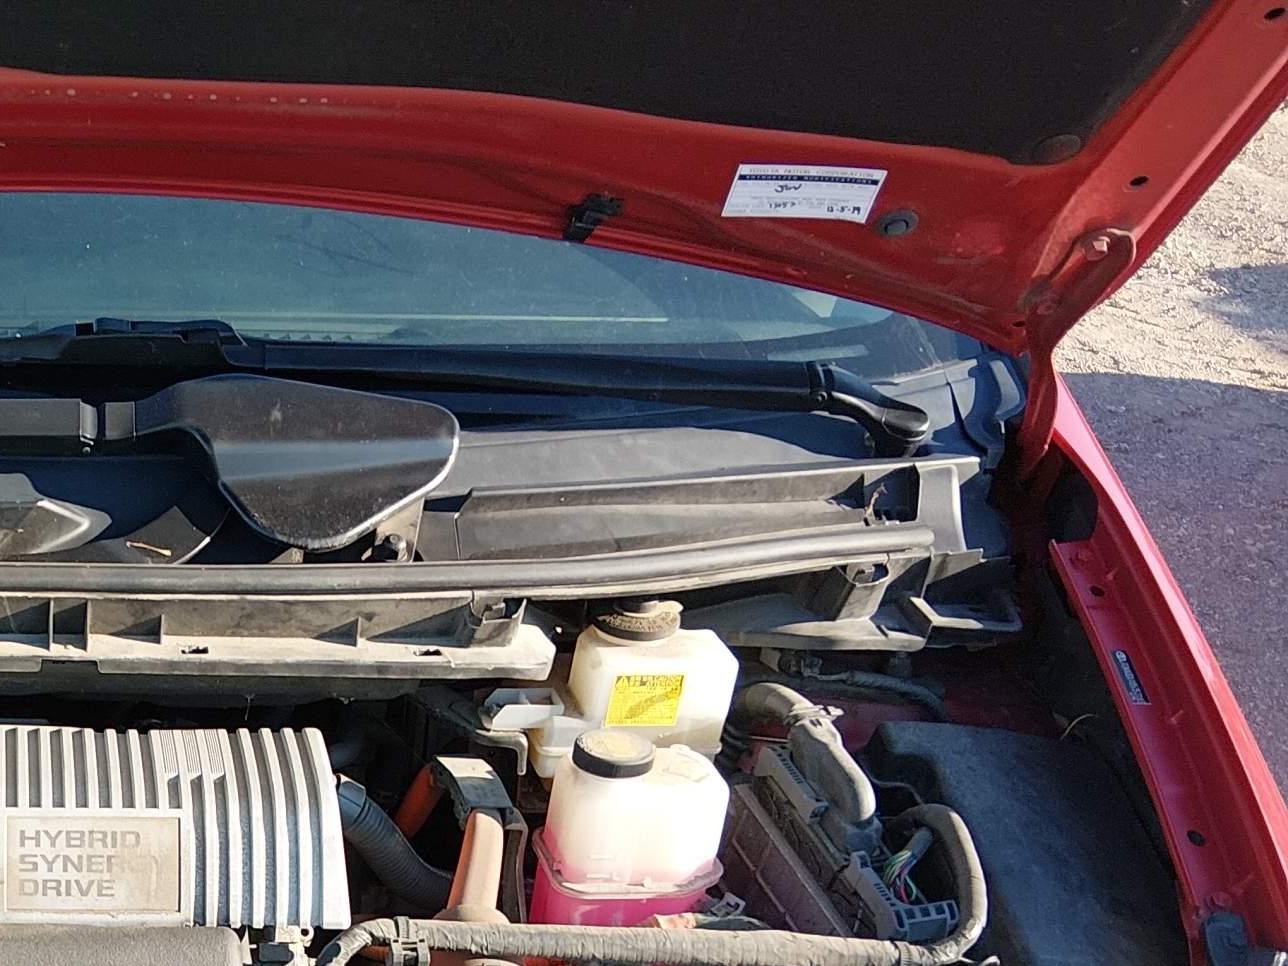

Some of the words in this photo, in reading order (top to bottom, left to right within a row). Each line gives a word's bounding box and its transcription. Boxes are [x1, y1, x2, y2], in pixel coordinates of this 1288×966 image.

[17, 829, 142, 849] HYBRID
[17, 853, 160, 873] SYNER
[17, 878, 117, 898] DRIVE
